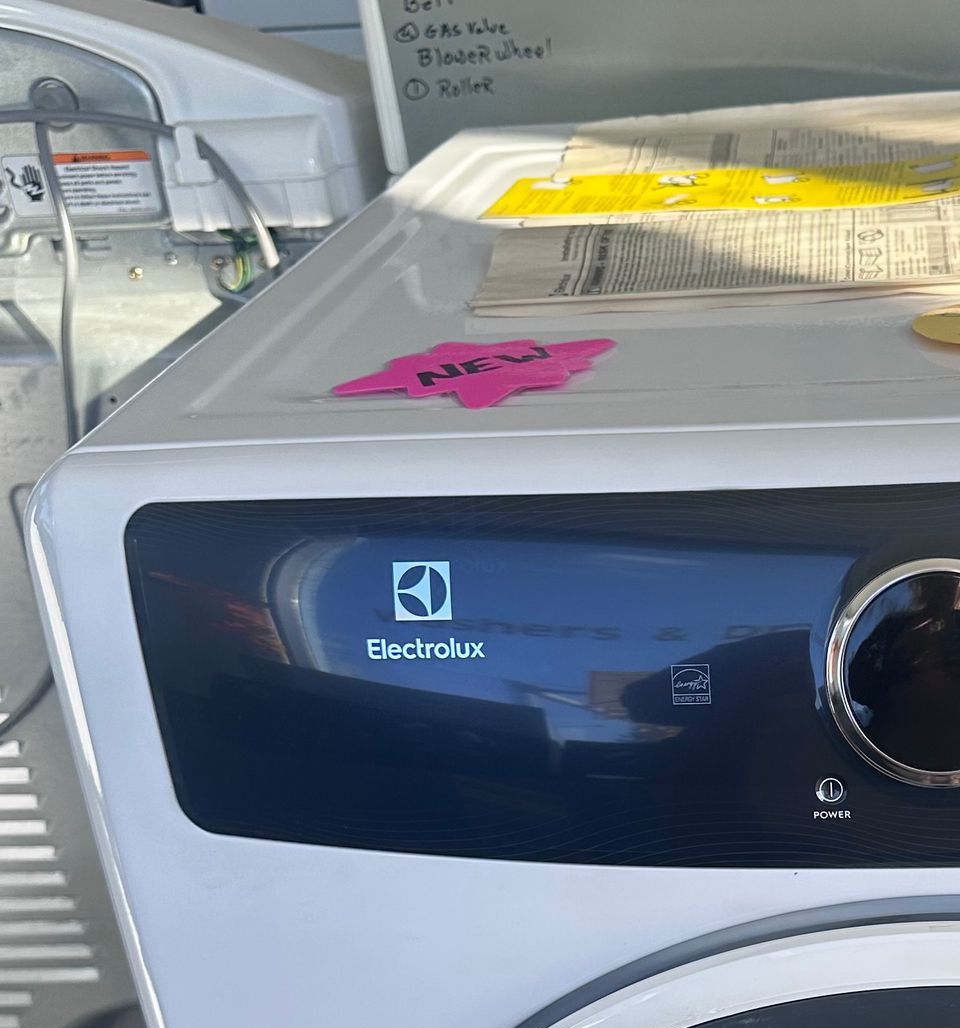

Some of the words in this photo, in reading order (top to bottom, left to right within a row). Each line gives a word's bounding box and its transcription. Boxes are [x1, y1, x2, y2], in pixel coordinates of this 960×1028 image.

[416, 346, 553, 387] NEW
[366, 637, 486, 660] Electrolux
[813, 810, 851, 819] POWER
